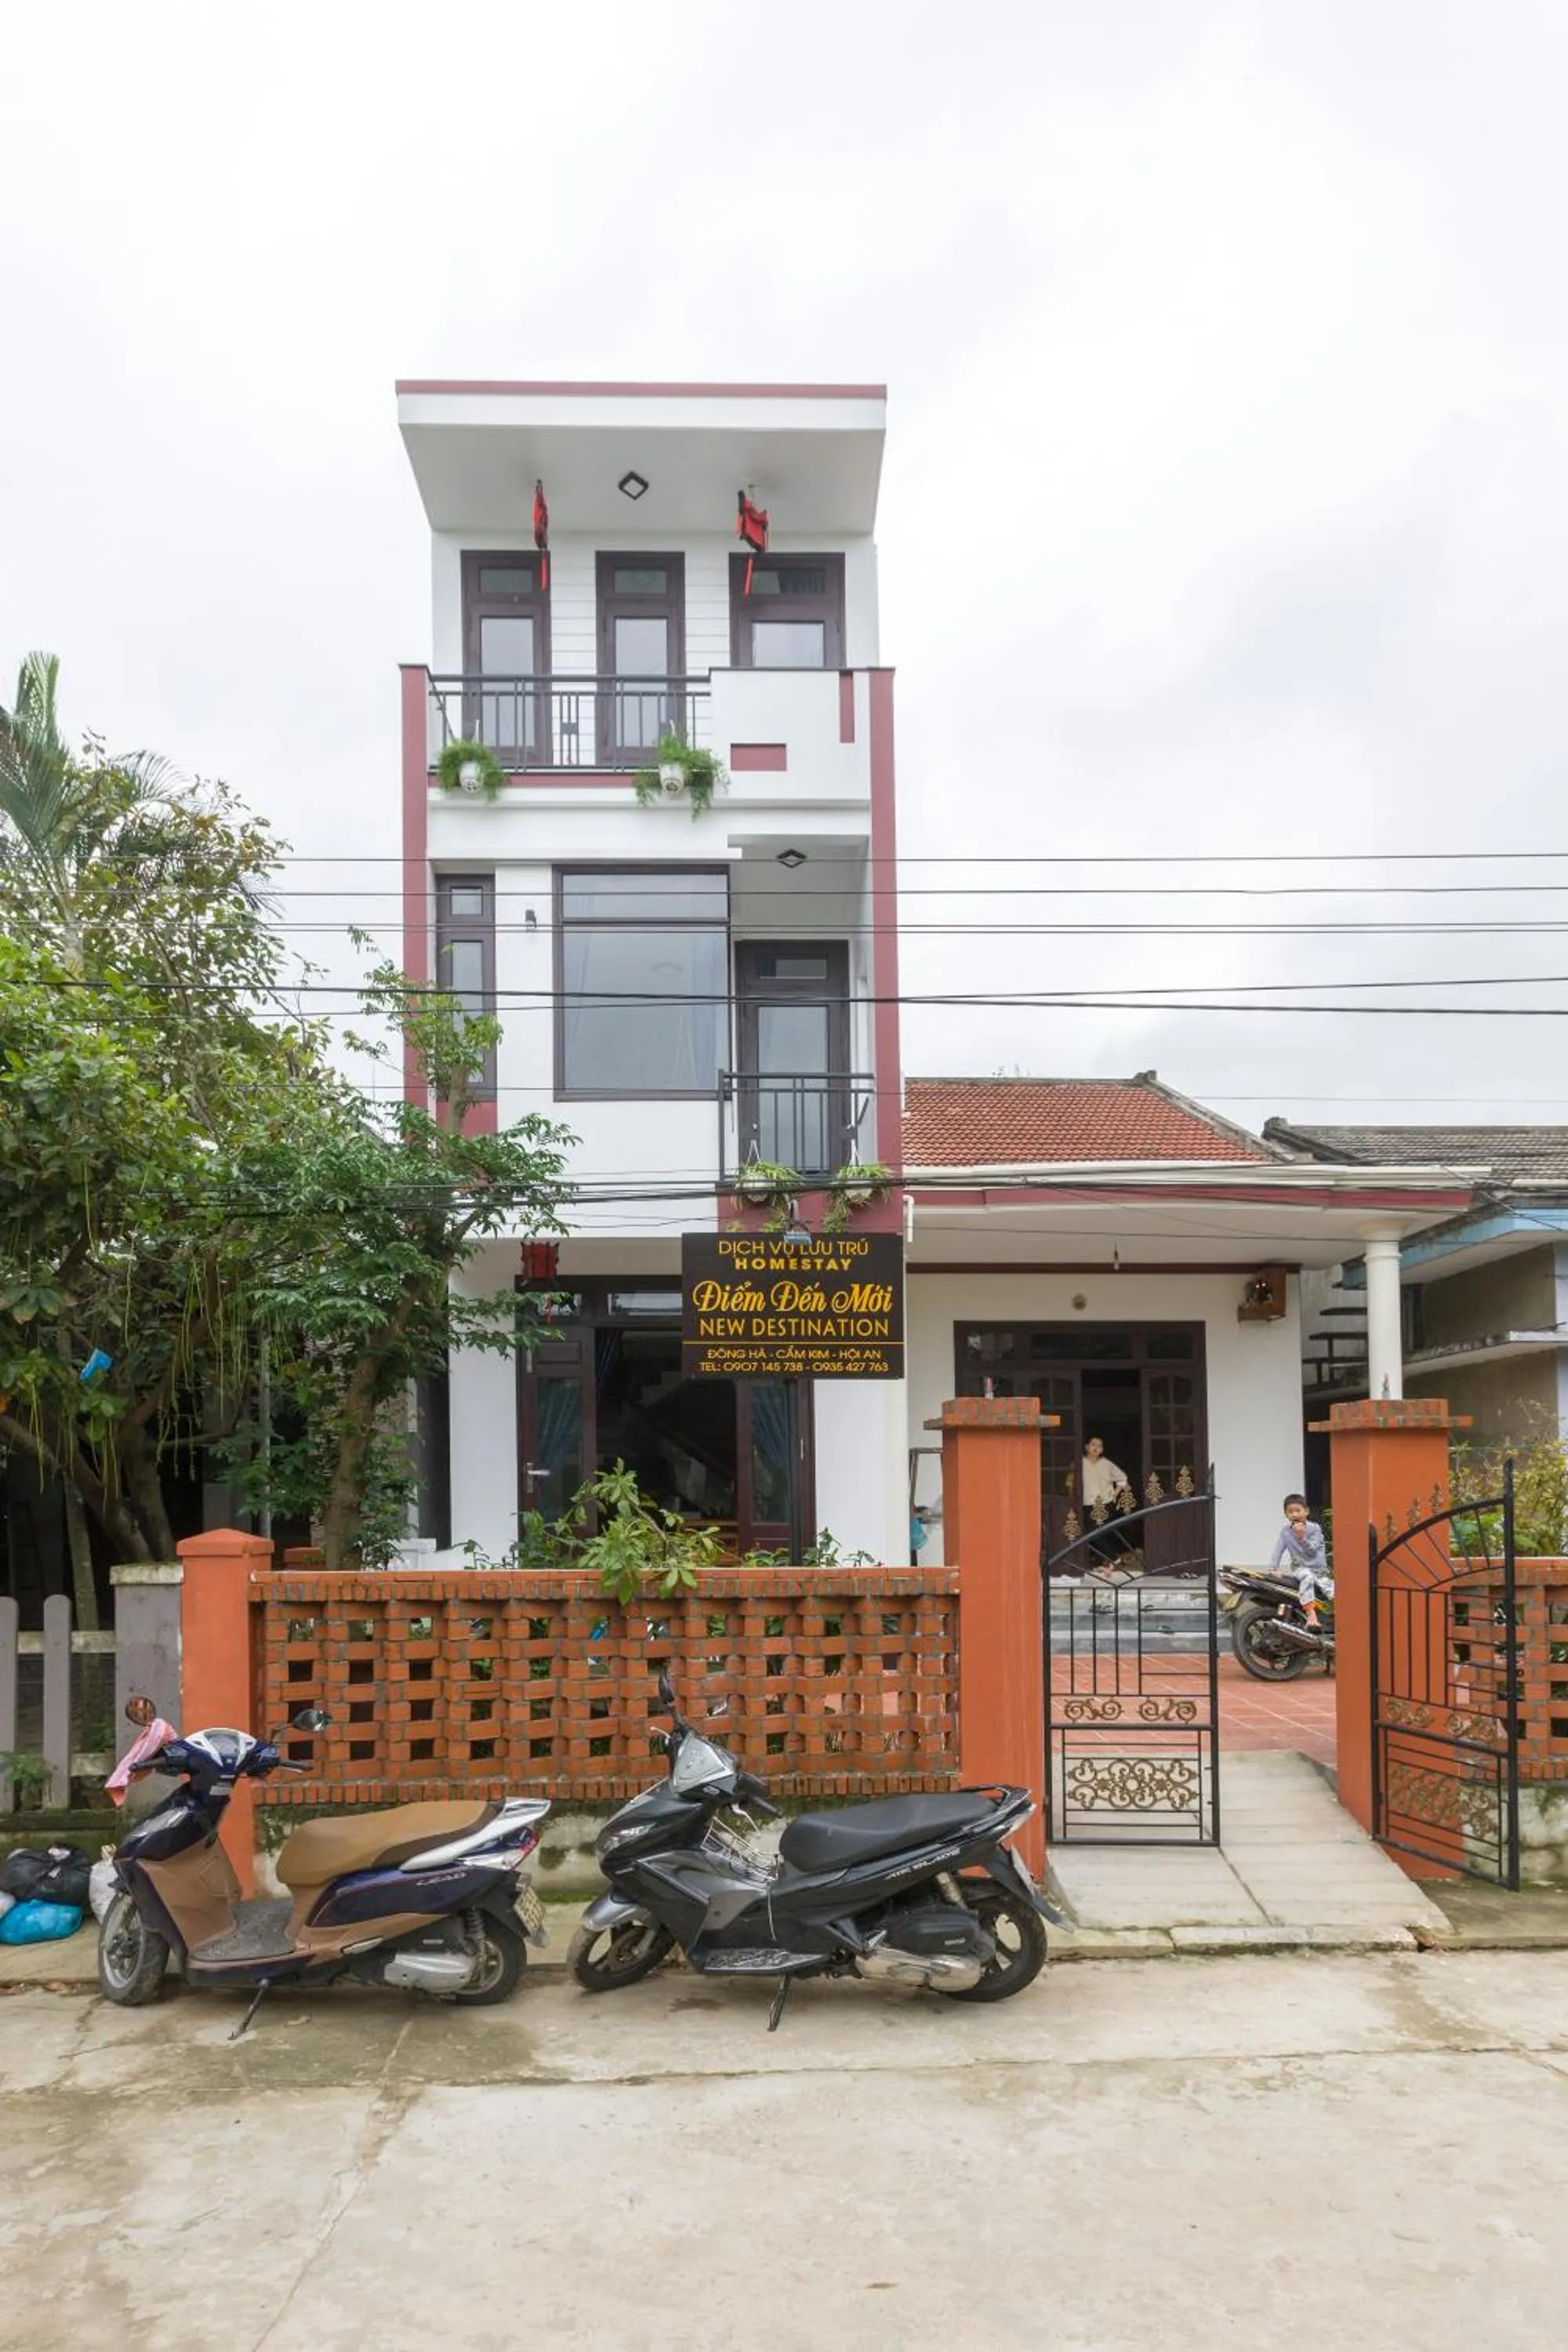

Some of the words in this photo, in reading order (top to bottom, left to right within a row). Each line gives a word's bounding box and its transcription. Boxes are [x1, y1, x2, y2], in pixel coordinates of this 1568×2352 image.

[718, 1240, 764, 1258] DỊCH
[837, 1237, 869, 1255] TRÚ
[734, 1258, 852, 1270] HOMESTAY
[693, 1279, 766, 1312] Điểm
[771, 1279, 827, 1312] Đến
[831, 1282, 894, 1313] Mới
[699, 1318, 746, 1337] NEW
[752, 1318, 889, 1337] DESTINATION
[808, 1349, 830, 1359] KIM
[839, 1348, 861, 1361] HỘI
[863, 1348, 882, 1359] AN
[699, 1361, 721, 1371] TEL:
[723, 1361, 758, 1371] 0907
[760, 1361, 781, 1371] 145
[782, 1361, 804, 1371] 738
[812, 1361, 844, 1371] 0935
[845, 1361, 866, 1371] 427
[867, 1361, 889, 1371] 763
